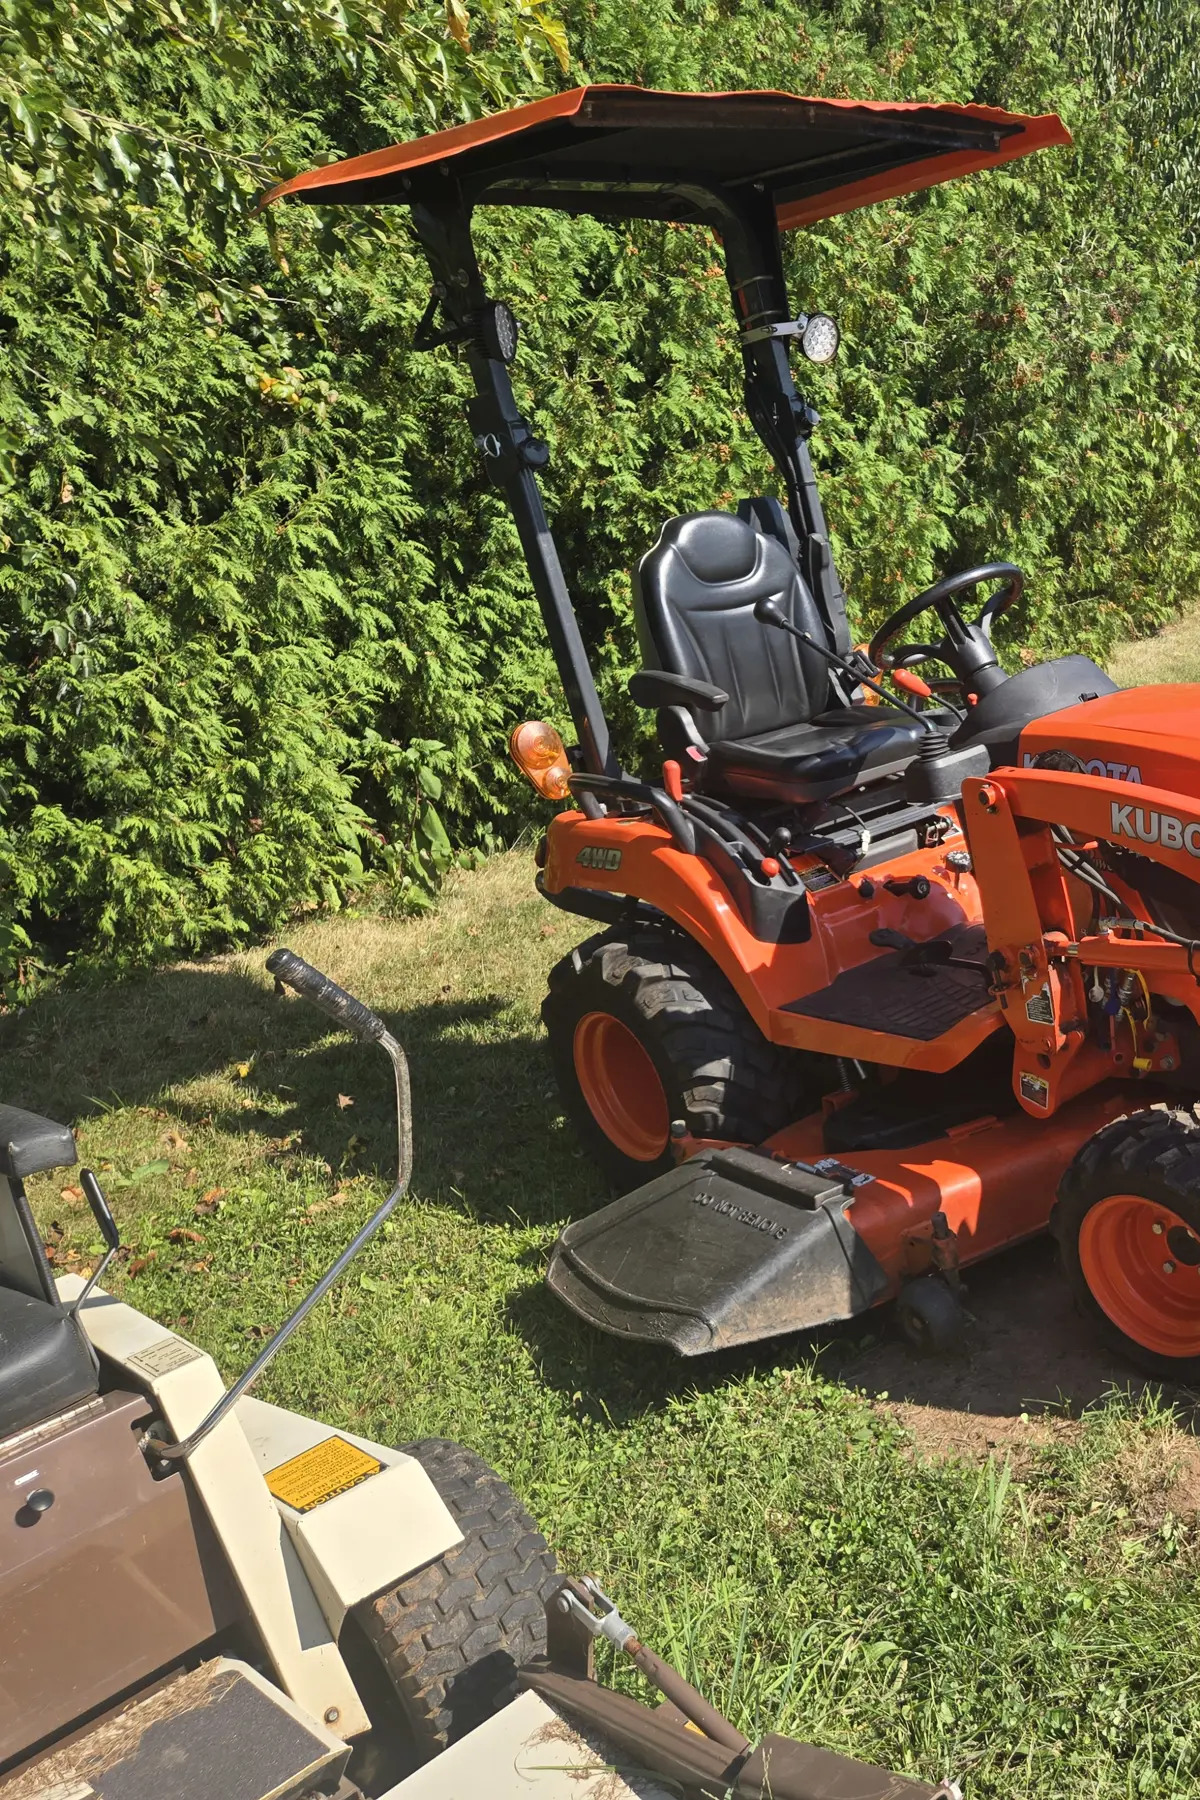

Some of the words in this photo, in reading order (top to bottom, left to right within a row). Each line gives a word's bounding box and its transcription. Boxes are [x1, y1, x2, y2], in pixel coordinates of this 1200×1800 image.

[1023, 753, 1142, 784] KOTA
[576, 846, 622, 871] 4WD
[692, 1192, 713, 1207] DO
[713, 1199, 742, 1218] NOT
[737, 1210, 789, 1240] REMOVE
[302, 1474, 366, 1511] CAUTION
